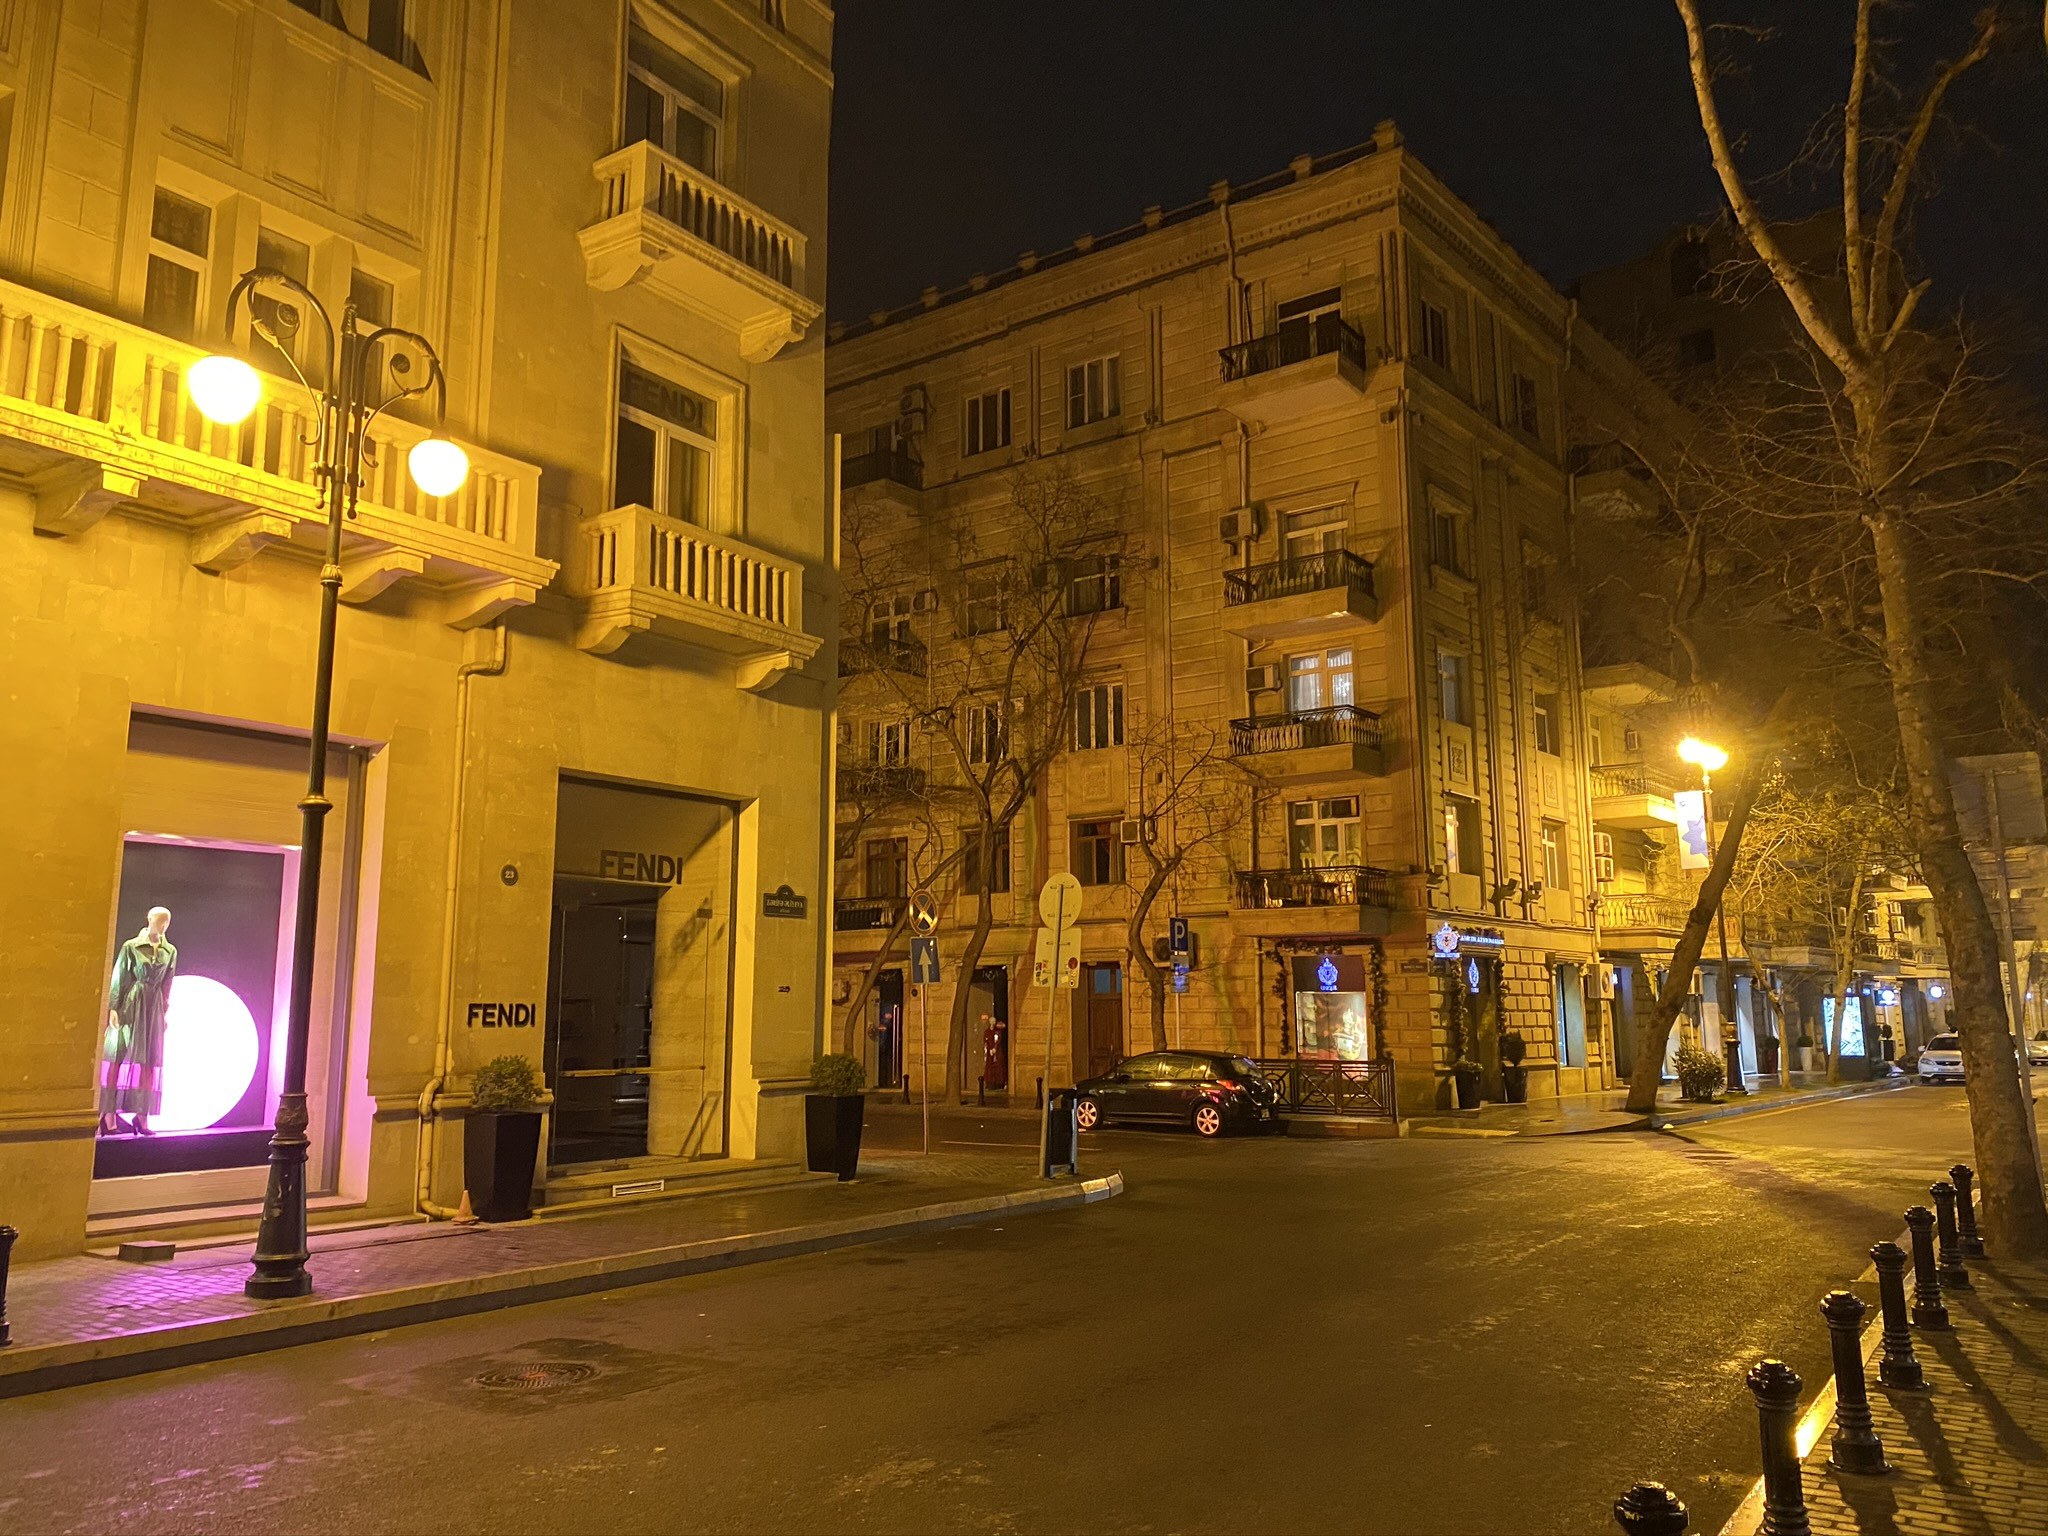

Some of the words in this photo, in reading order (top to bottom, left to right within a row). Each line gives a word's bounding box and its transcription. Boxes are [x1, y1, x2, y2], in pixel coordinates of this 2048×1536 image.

[600, 849, 683, 885] FENDI
[1174, 921, 1186, 948] P
[467, 1003, 536, 1028] FENDI
